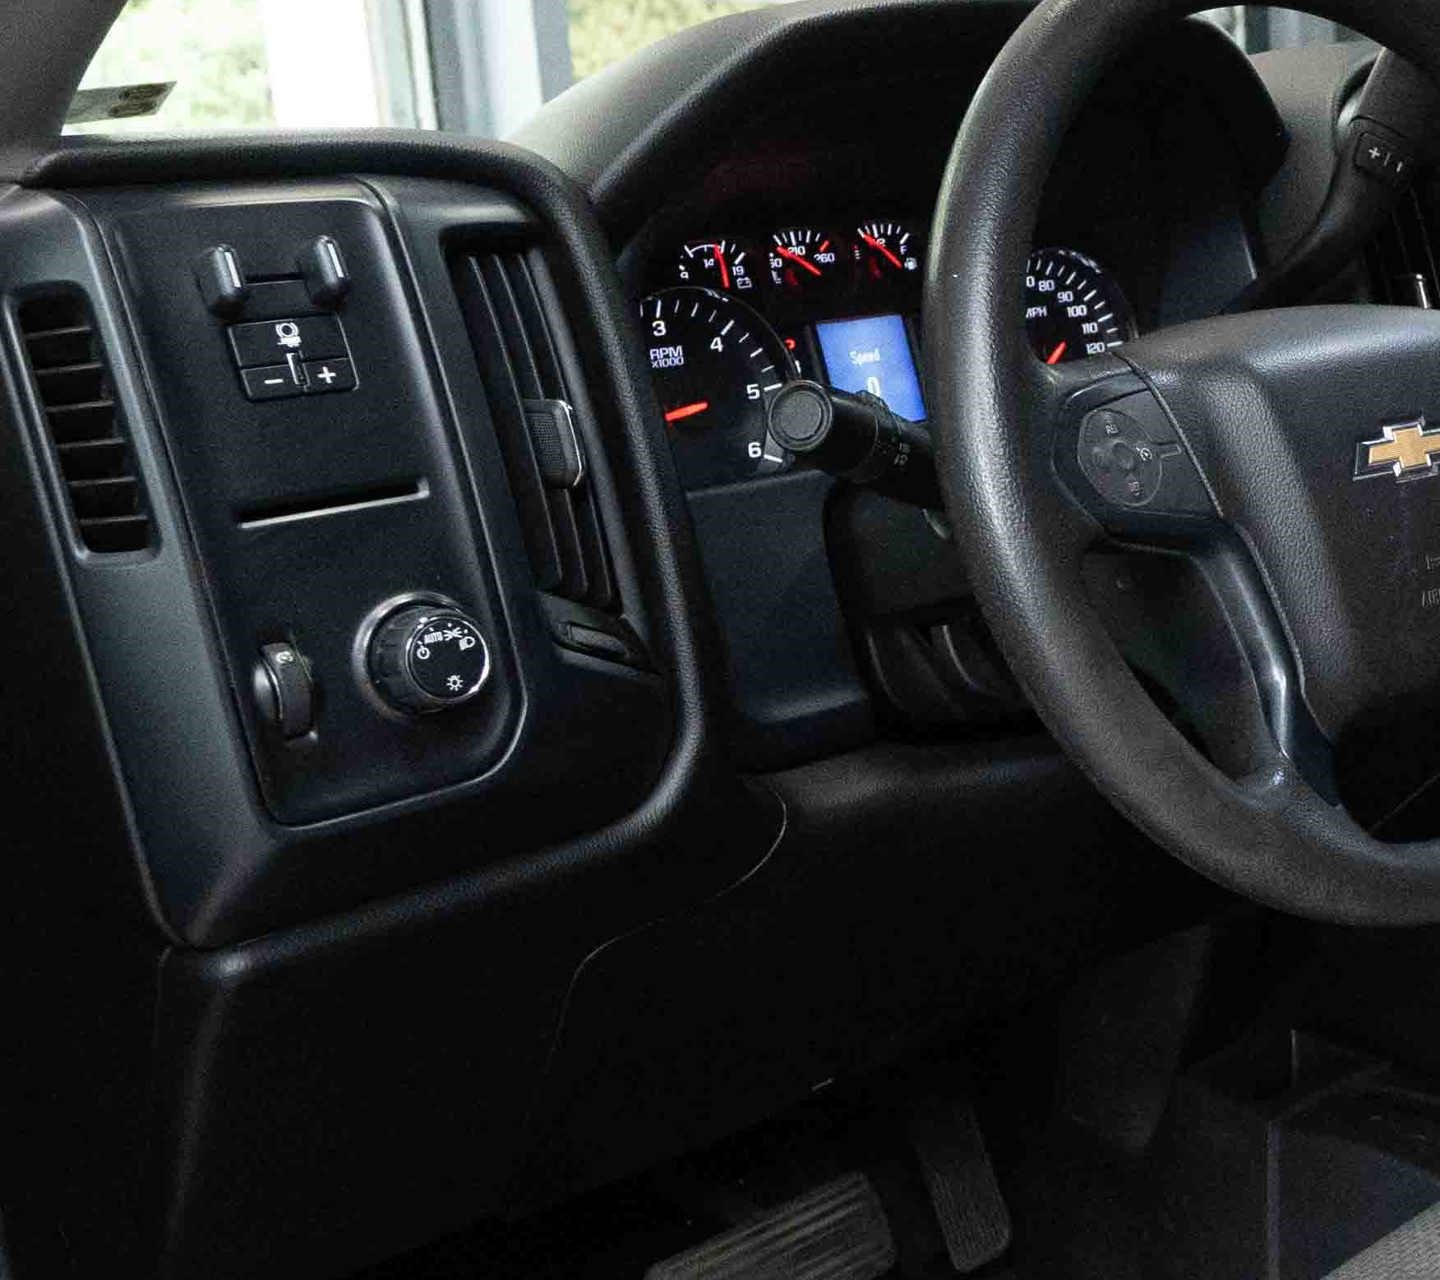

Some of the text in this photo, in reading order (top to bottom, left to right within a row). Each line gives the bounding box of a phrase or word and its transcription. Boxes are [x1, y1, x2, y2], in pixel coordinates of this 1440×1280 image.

[732, 265, 744, 276] 19
[1038, 279, 1056, 293] 80
[1057, 291, 1074, 304] 90
[1066, 304, 1088, 318] 100
[652, 320, 667, 337] 3
[1081, 321, 1099, 335] 110
[649, 344, 683, 361] RPM
[709, 336, 724, 353] 4
[1086, 342, 1106, 355] 120
[848, 347, 881, 367] Speed
[746, 384, 761, 400] 5
[866, 375, 881, 398] 0
[747, 442, 762, 459] 6
